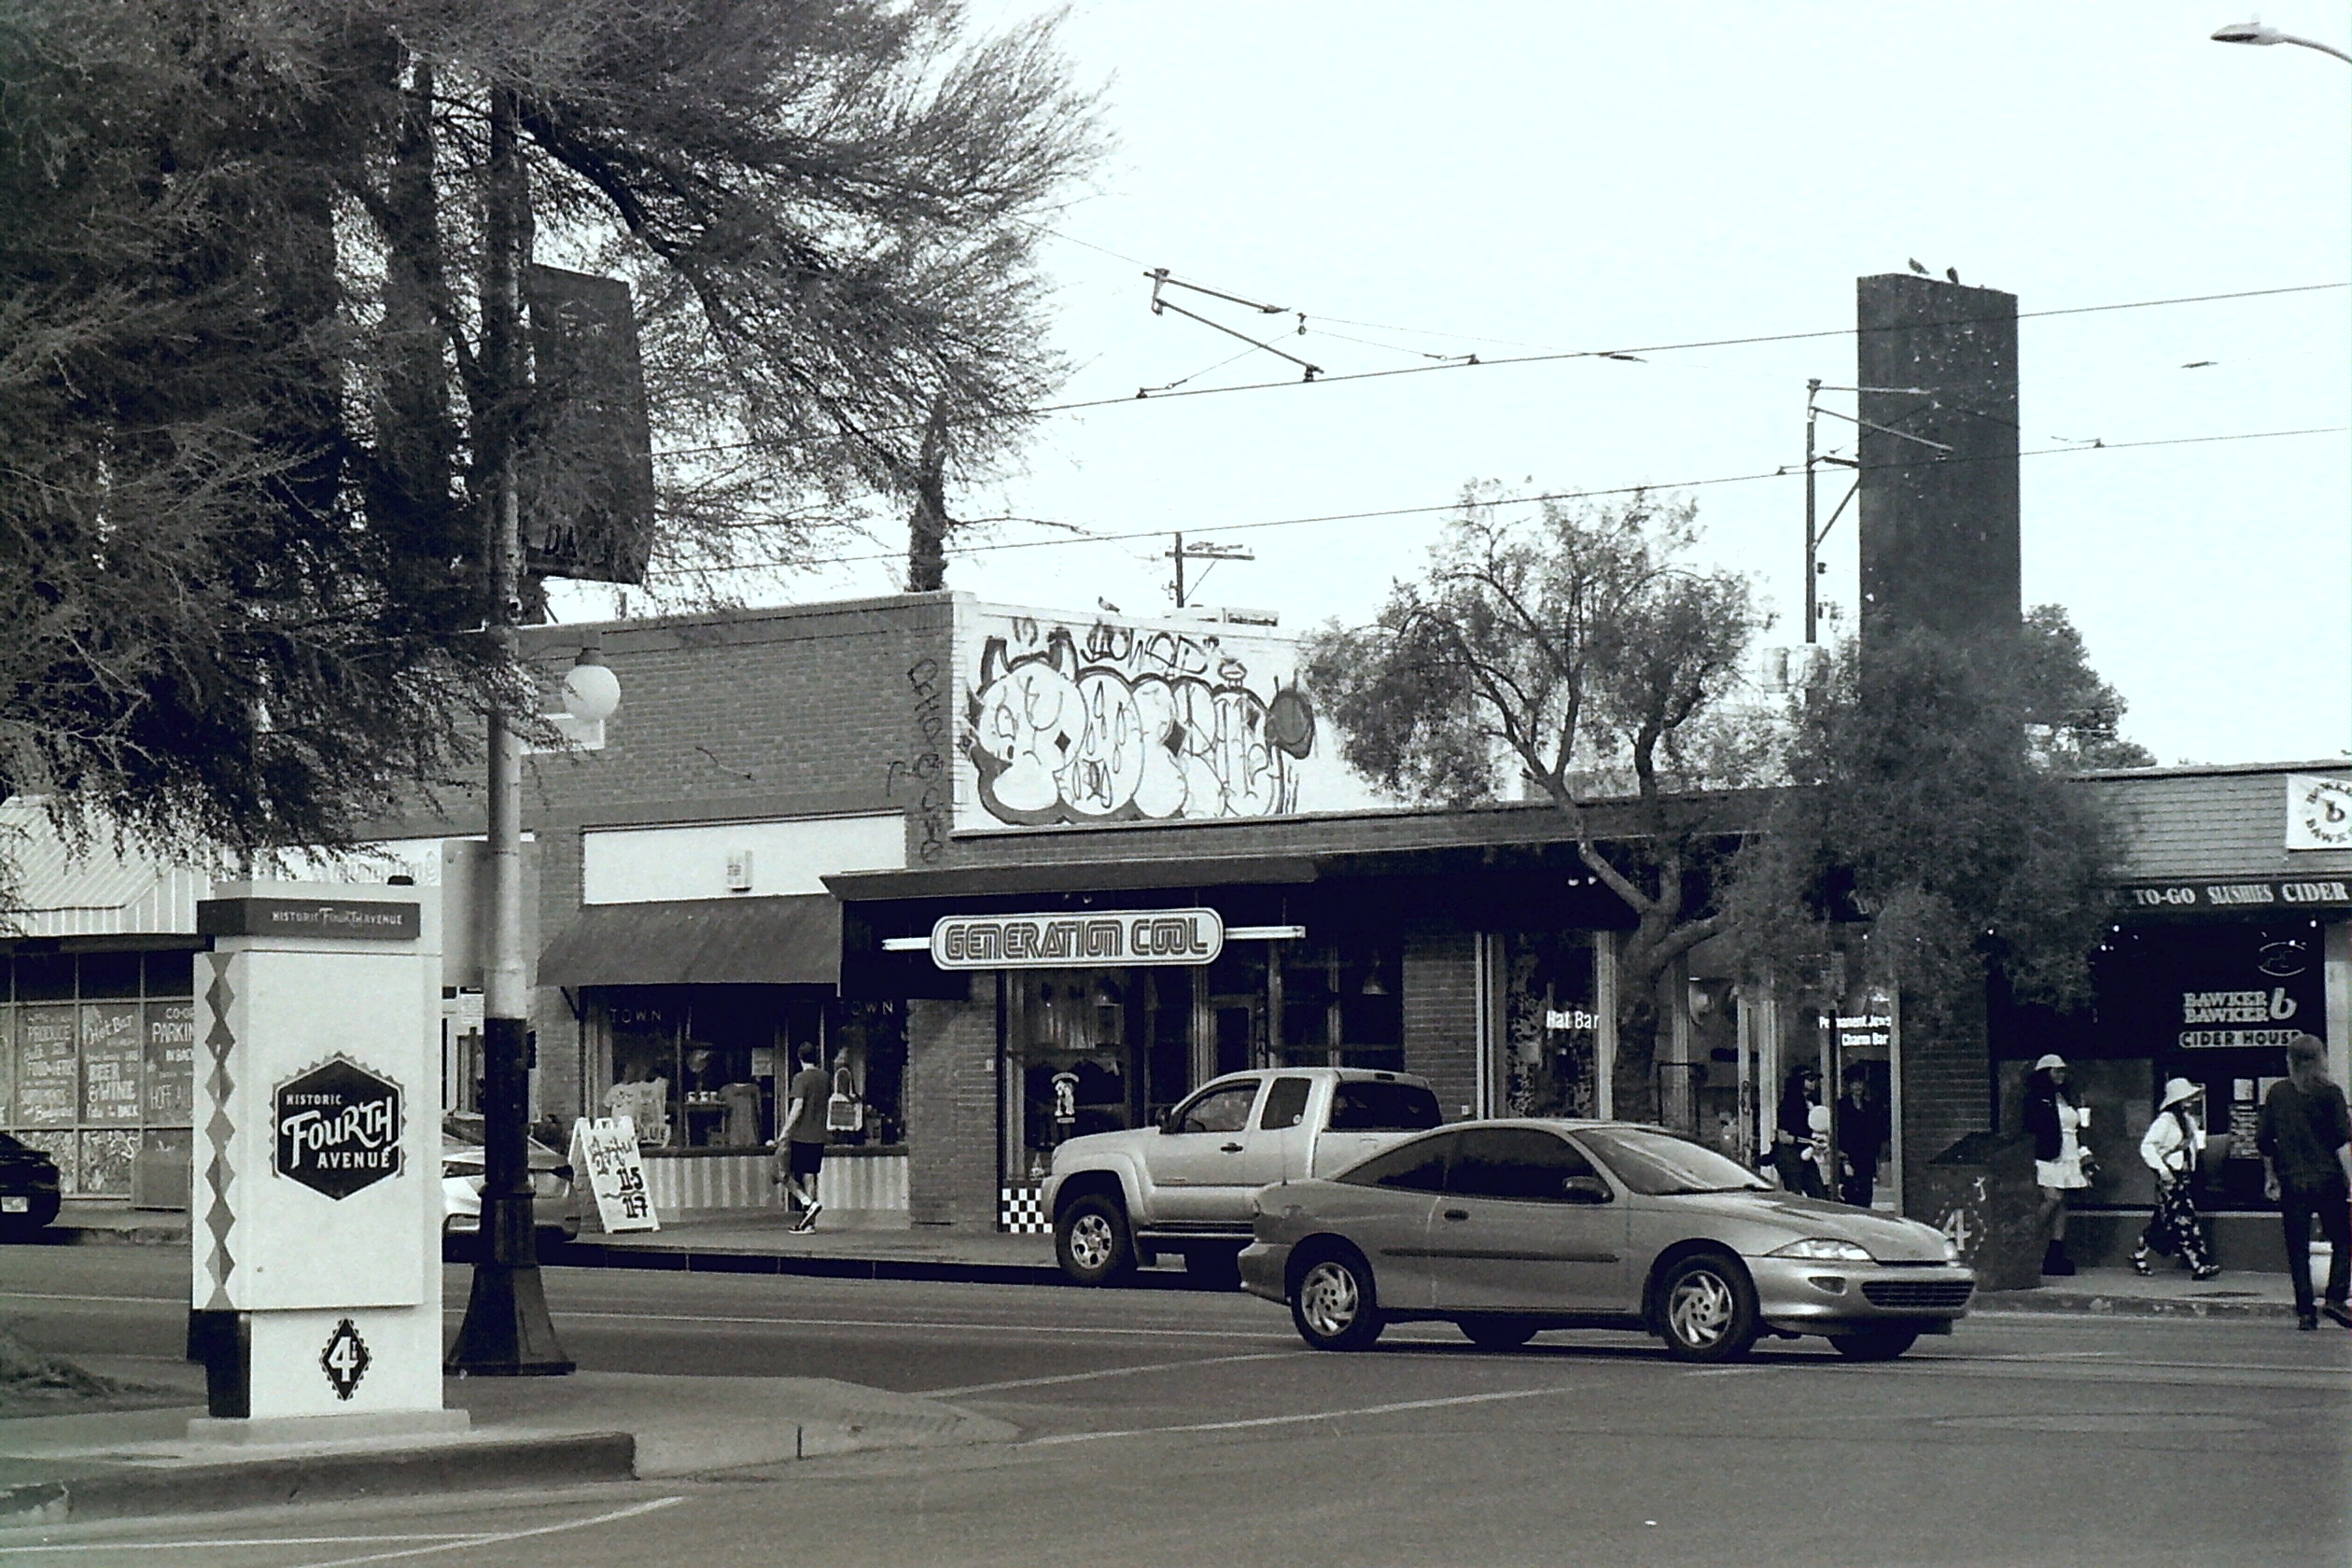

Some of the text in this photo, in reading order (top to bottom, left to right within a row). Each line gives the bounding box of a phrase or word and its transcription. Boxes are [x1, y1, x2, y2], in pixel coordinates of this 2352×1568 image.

[2134, 888, 2196, 905] TO-GO
[2282, 882, 2350, 902] CIDER
[272, 911, 319, 922] HISTORIC
[364, 914, 403, 926] AVENUE
[945, 917, 1209, 960] GENERATION COOL
[2183, 990, 2268, 1007] BAWKER
[609, 1008, 662, 1024] TOWN
[1547, 1009, 1600, 1029] Hat Bar
[2184, 1007, 2270, 1024] BAWKER
[152, 1022, 193, 1043] PARKIN
[1871, 1031, 1889, 1045] Bar
[2181, 1031, 2235, 1047] CIDER
[175, 1048, 194, 1062] BAC
[286, 1094, 342, 1106] HISTORIC
[317, 1147, 391, 1169] AVENUE
